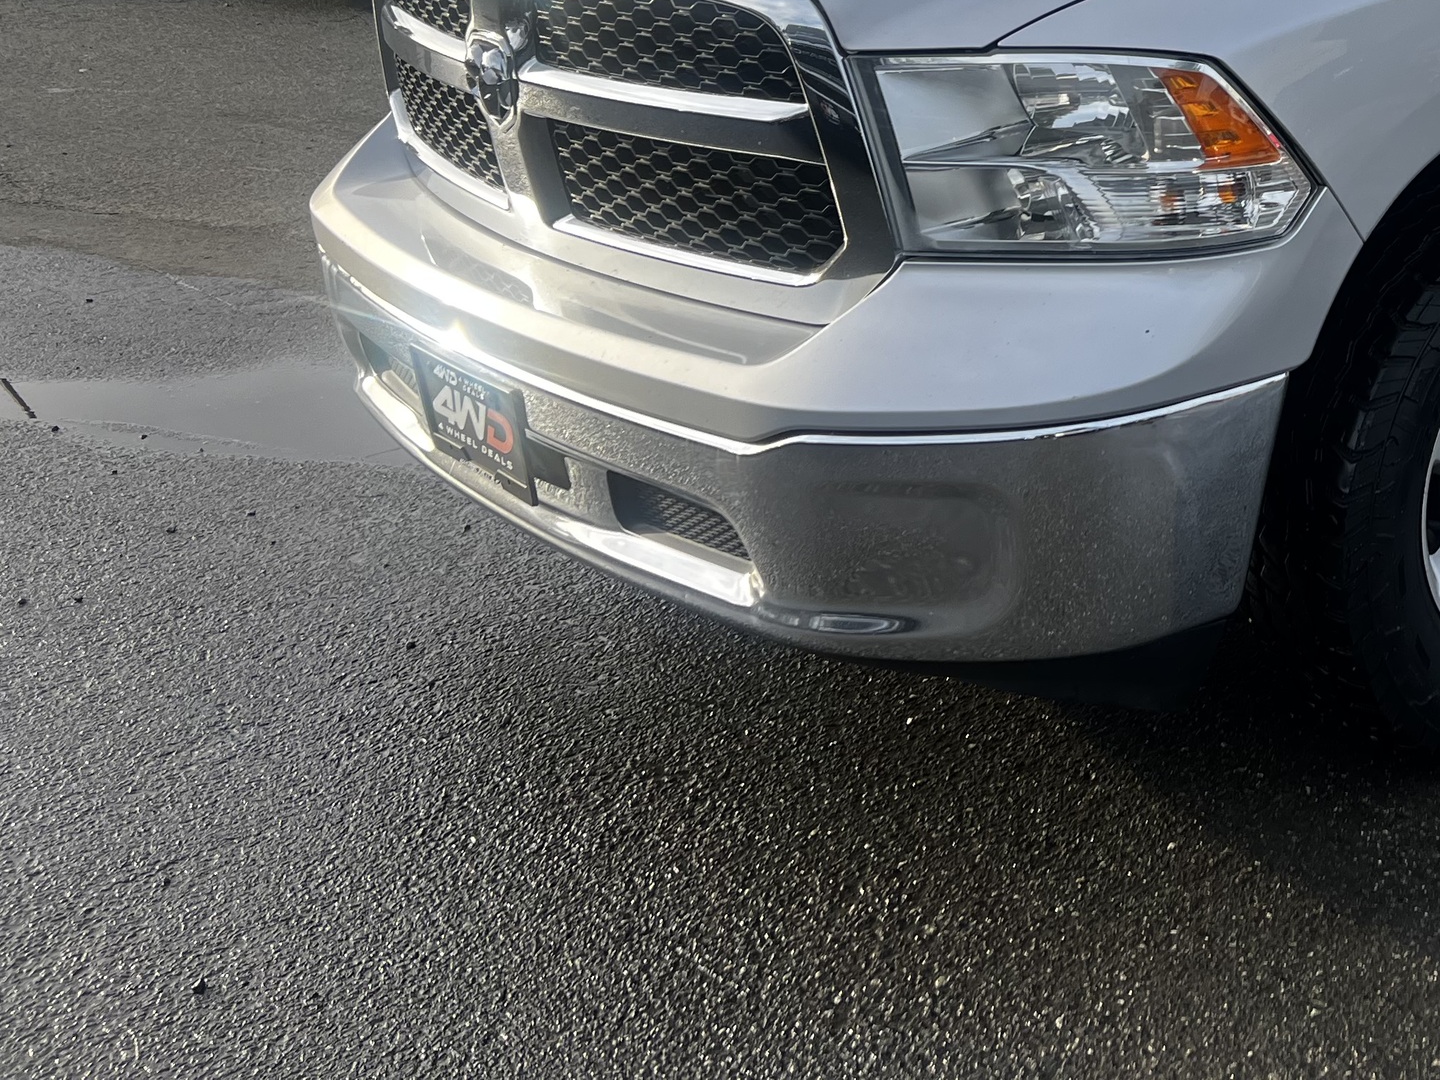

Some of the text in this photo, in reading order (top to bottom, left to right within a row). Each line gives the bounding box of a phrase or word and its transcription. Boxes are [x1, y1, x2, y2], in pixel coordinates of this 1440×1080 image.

[433, 364, 458, 386] 4WD
[432, 385, 514, 454] 4WD
[446, 425, 478, 449] WHEEL
[481, 445, 514, 471] DEALS
